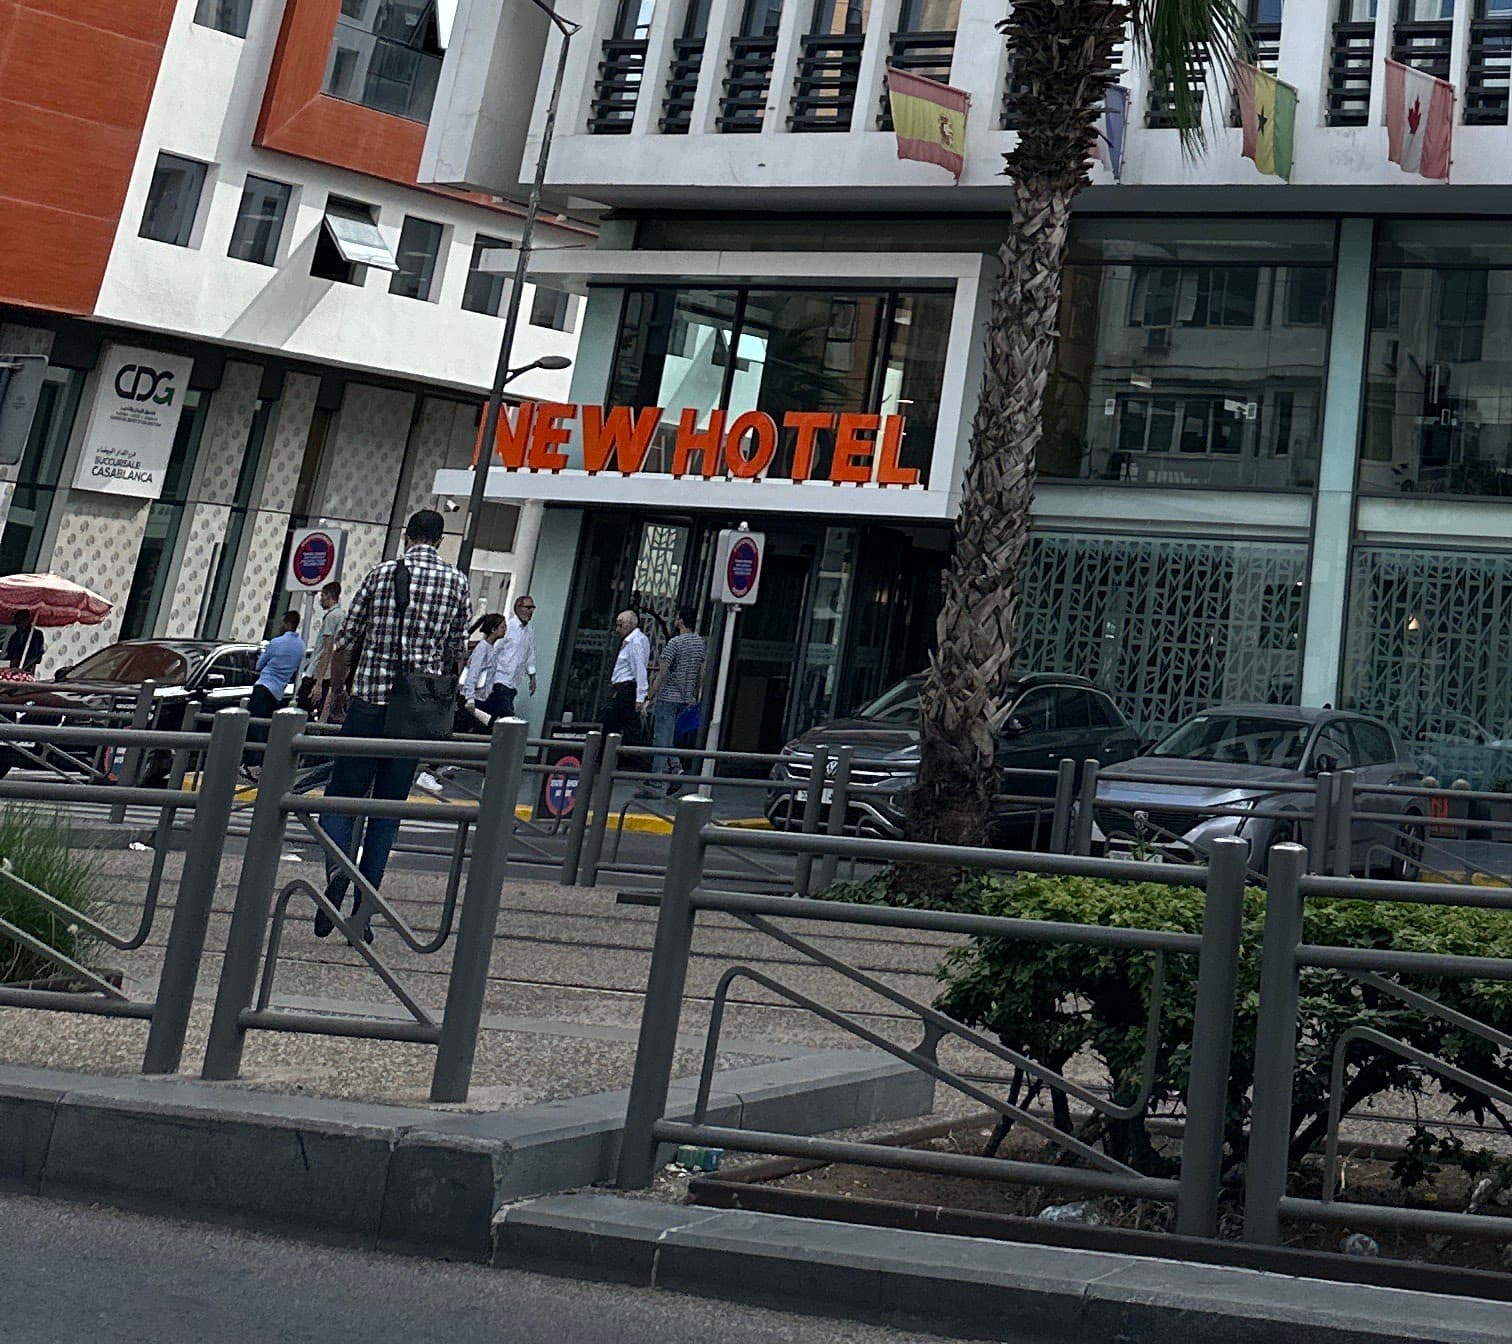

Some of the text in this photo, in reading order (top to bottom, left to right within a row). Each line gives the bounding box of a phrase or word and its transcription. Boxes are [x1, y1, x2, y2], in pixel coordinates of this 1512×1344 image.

[114, 363, 176, 407] CDG
[474, 401, 920, 485] NEW HOTEL
[91, 466, 153, 483] CASABLANCA
[94, 456, 142, 470] SUCCURSALE
